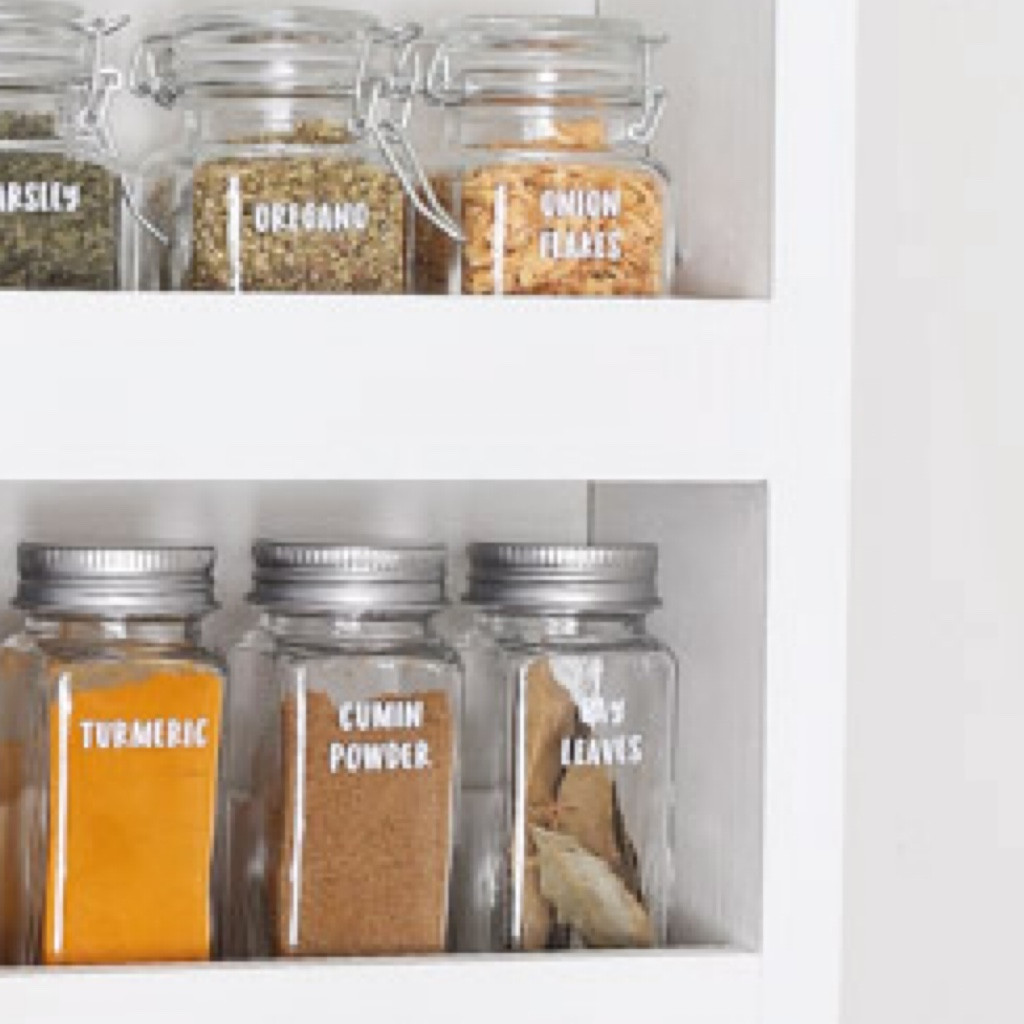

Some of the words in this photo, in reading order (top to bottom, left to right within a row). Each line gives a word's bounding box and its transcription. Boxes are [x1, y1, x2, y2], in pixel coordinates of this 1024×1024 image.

[255, 202, 369, 233] OREGANO
[540, 189, 621, 217] ONION
[539, 229, 622, 259] FLAKES
[338, 701, 424, 731] CUMIN
[80, 718, 210, 749] TURMERIC
[330, 740, 432, 773] POWDER
[561, 735, 642, 766] LEAVES
